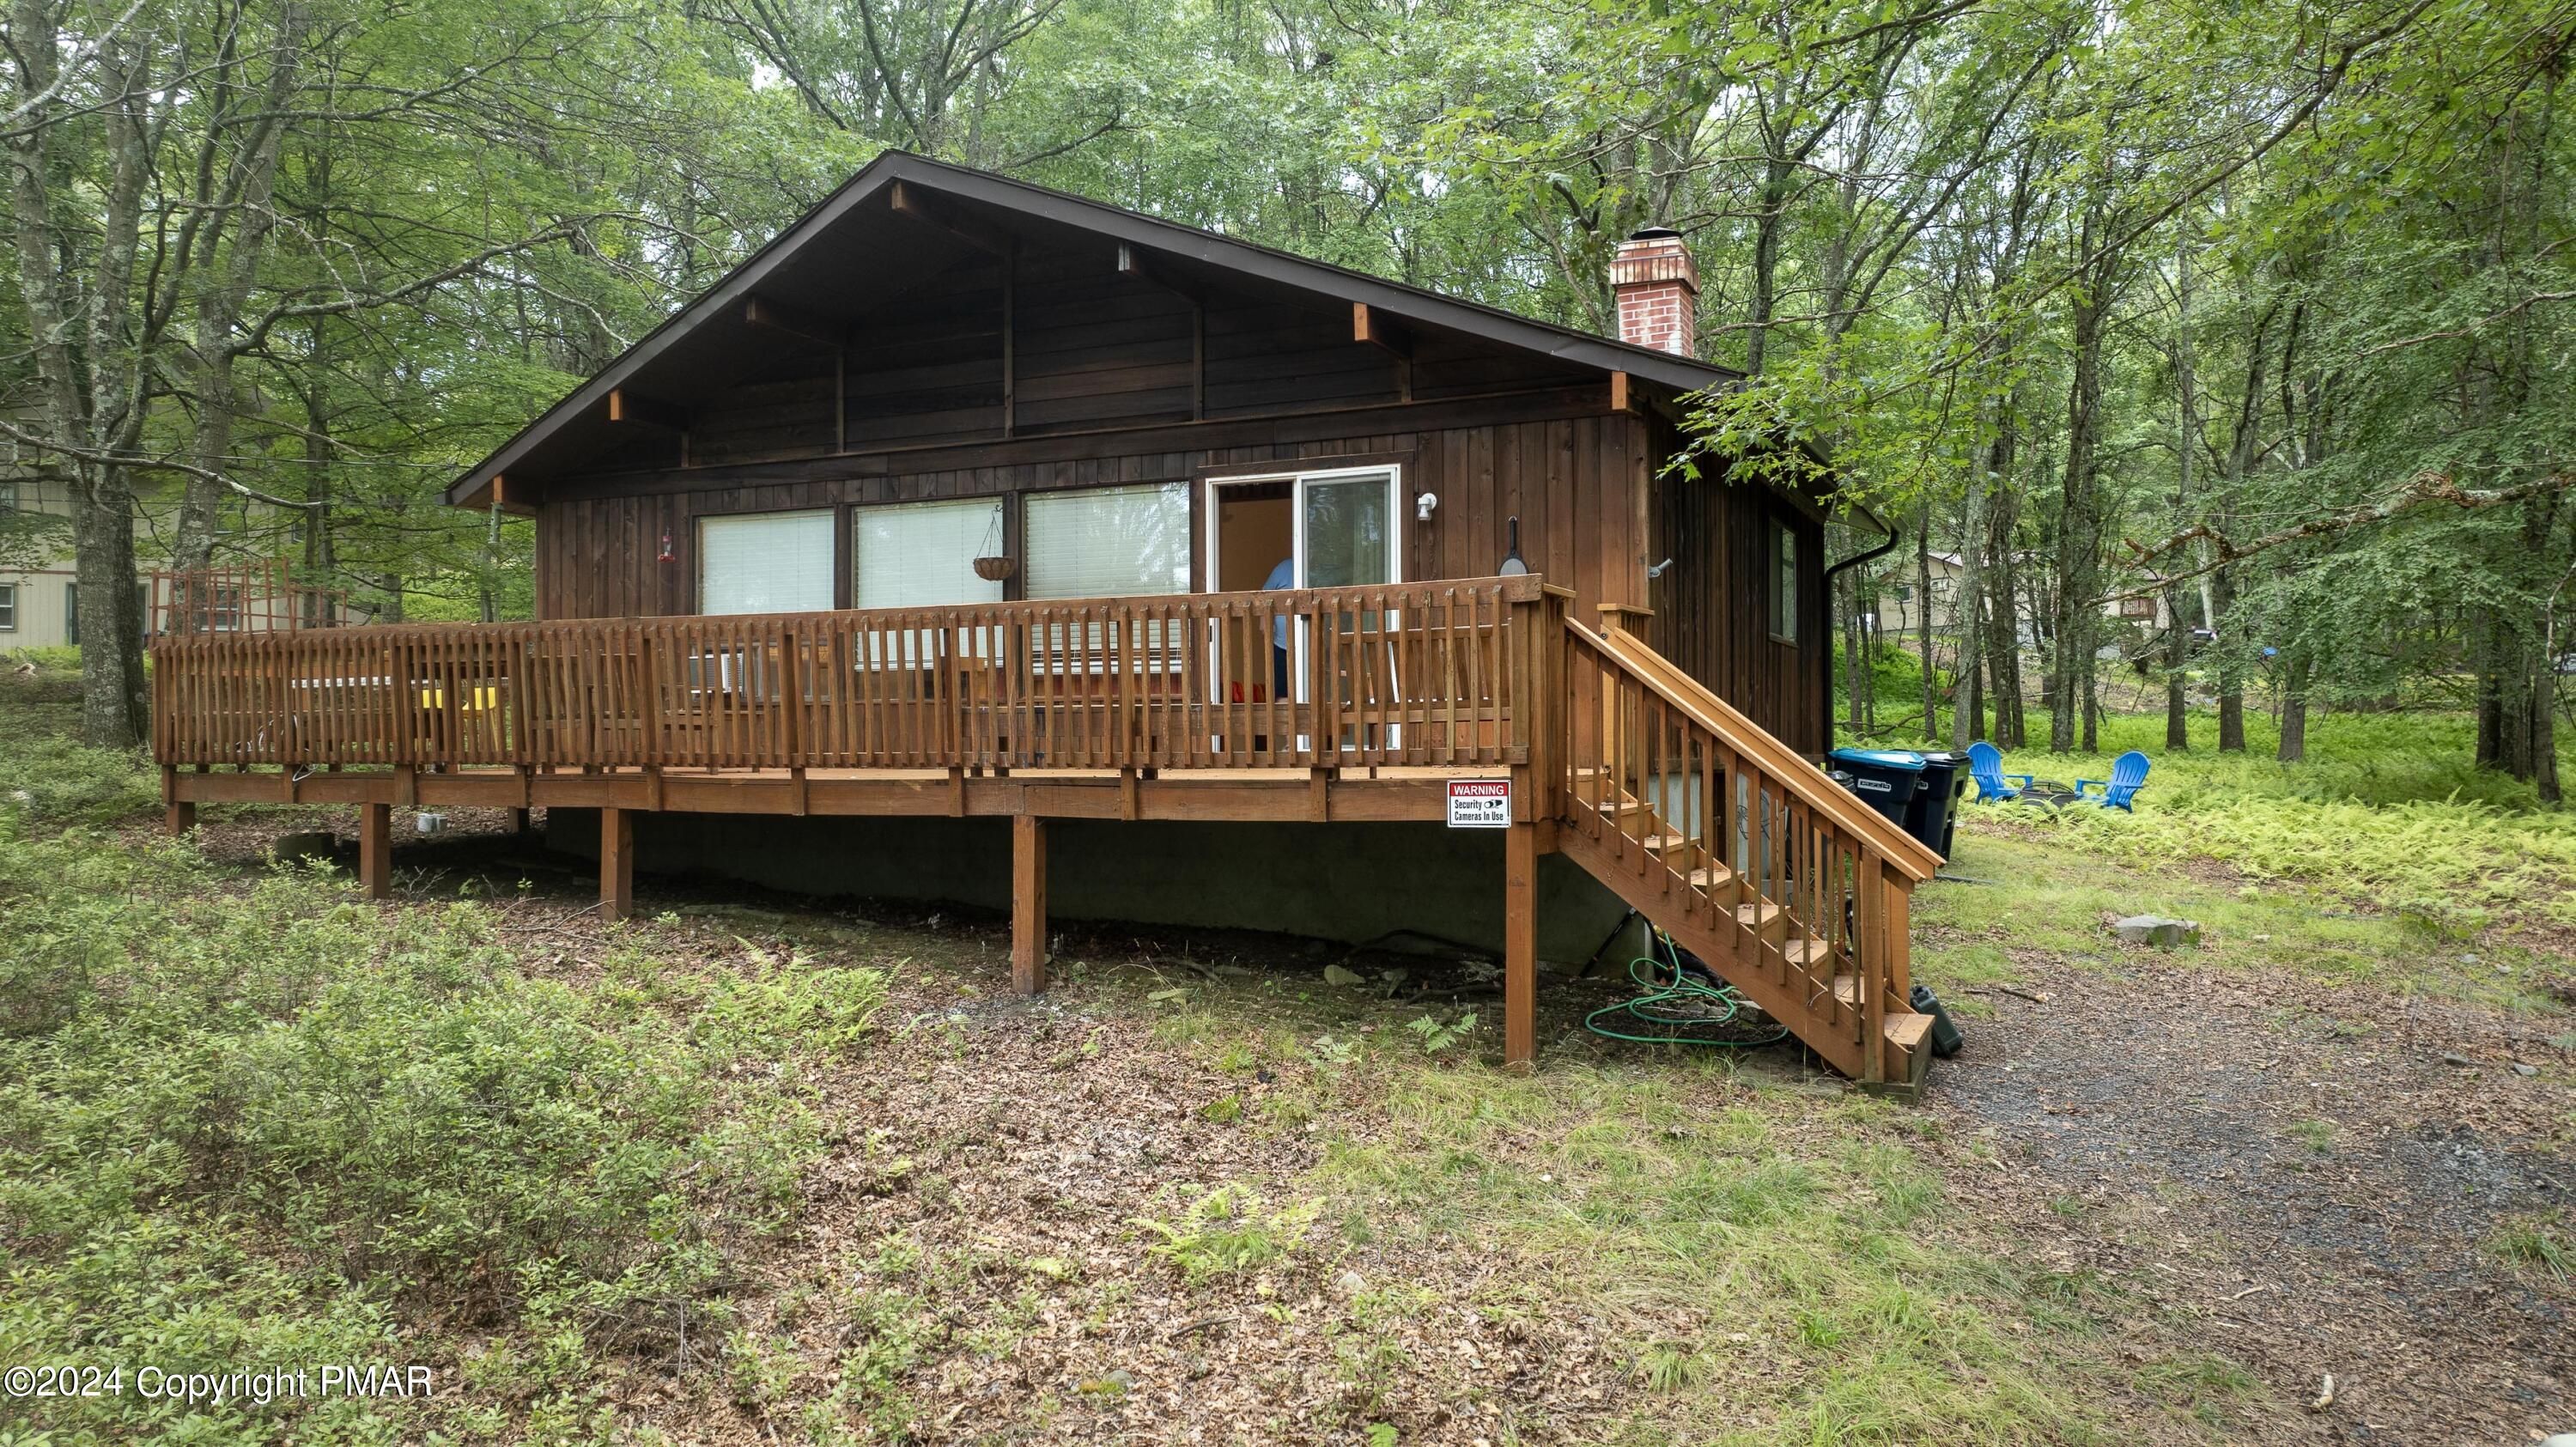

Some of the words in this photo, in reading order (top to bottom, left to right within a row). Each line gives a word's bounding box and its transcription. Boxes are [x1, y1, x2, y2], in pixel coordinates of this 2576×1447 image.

[1454, 785, 1504, 795] WARNING
[1455, 799, 1482, 811] Security
[1455, 812, 1482, 821] Cameras
[1484, 812, 1490, 821] In
[1492, 812, 1504, 821] Use
